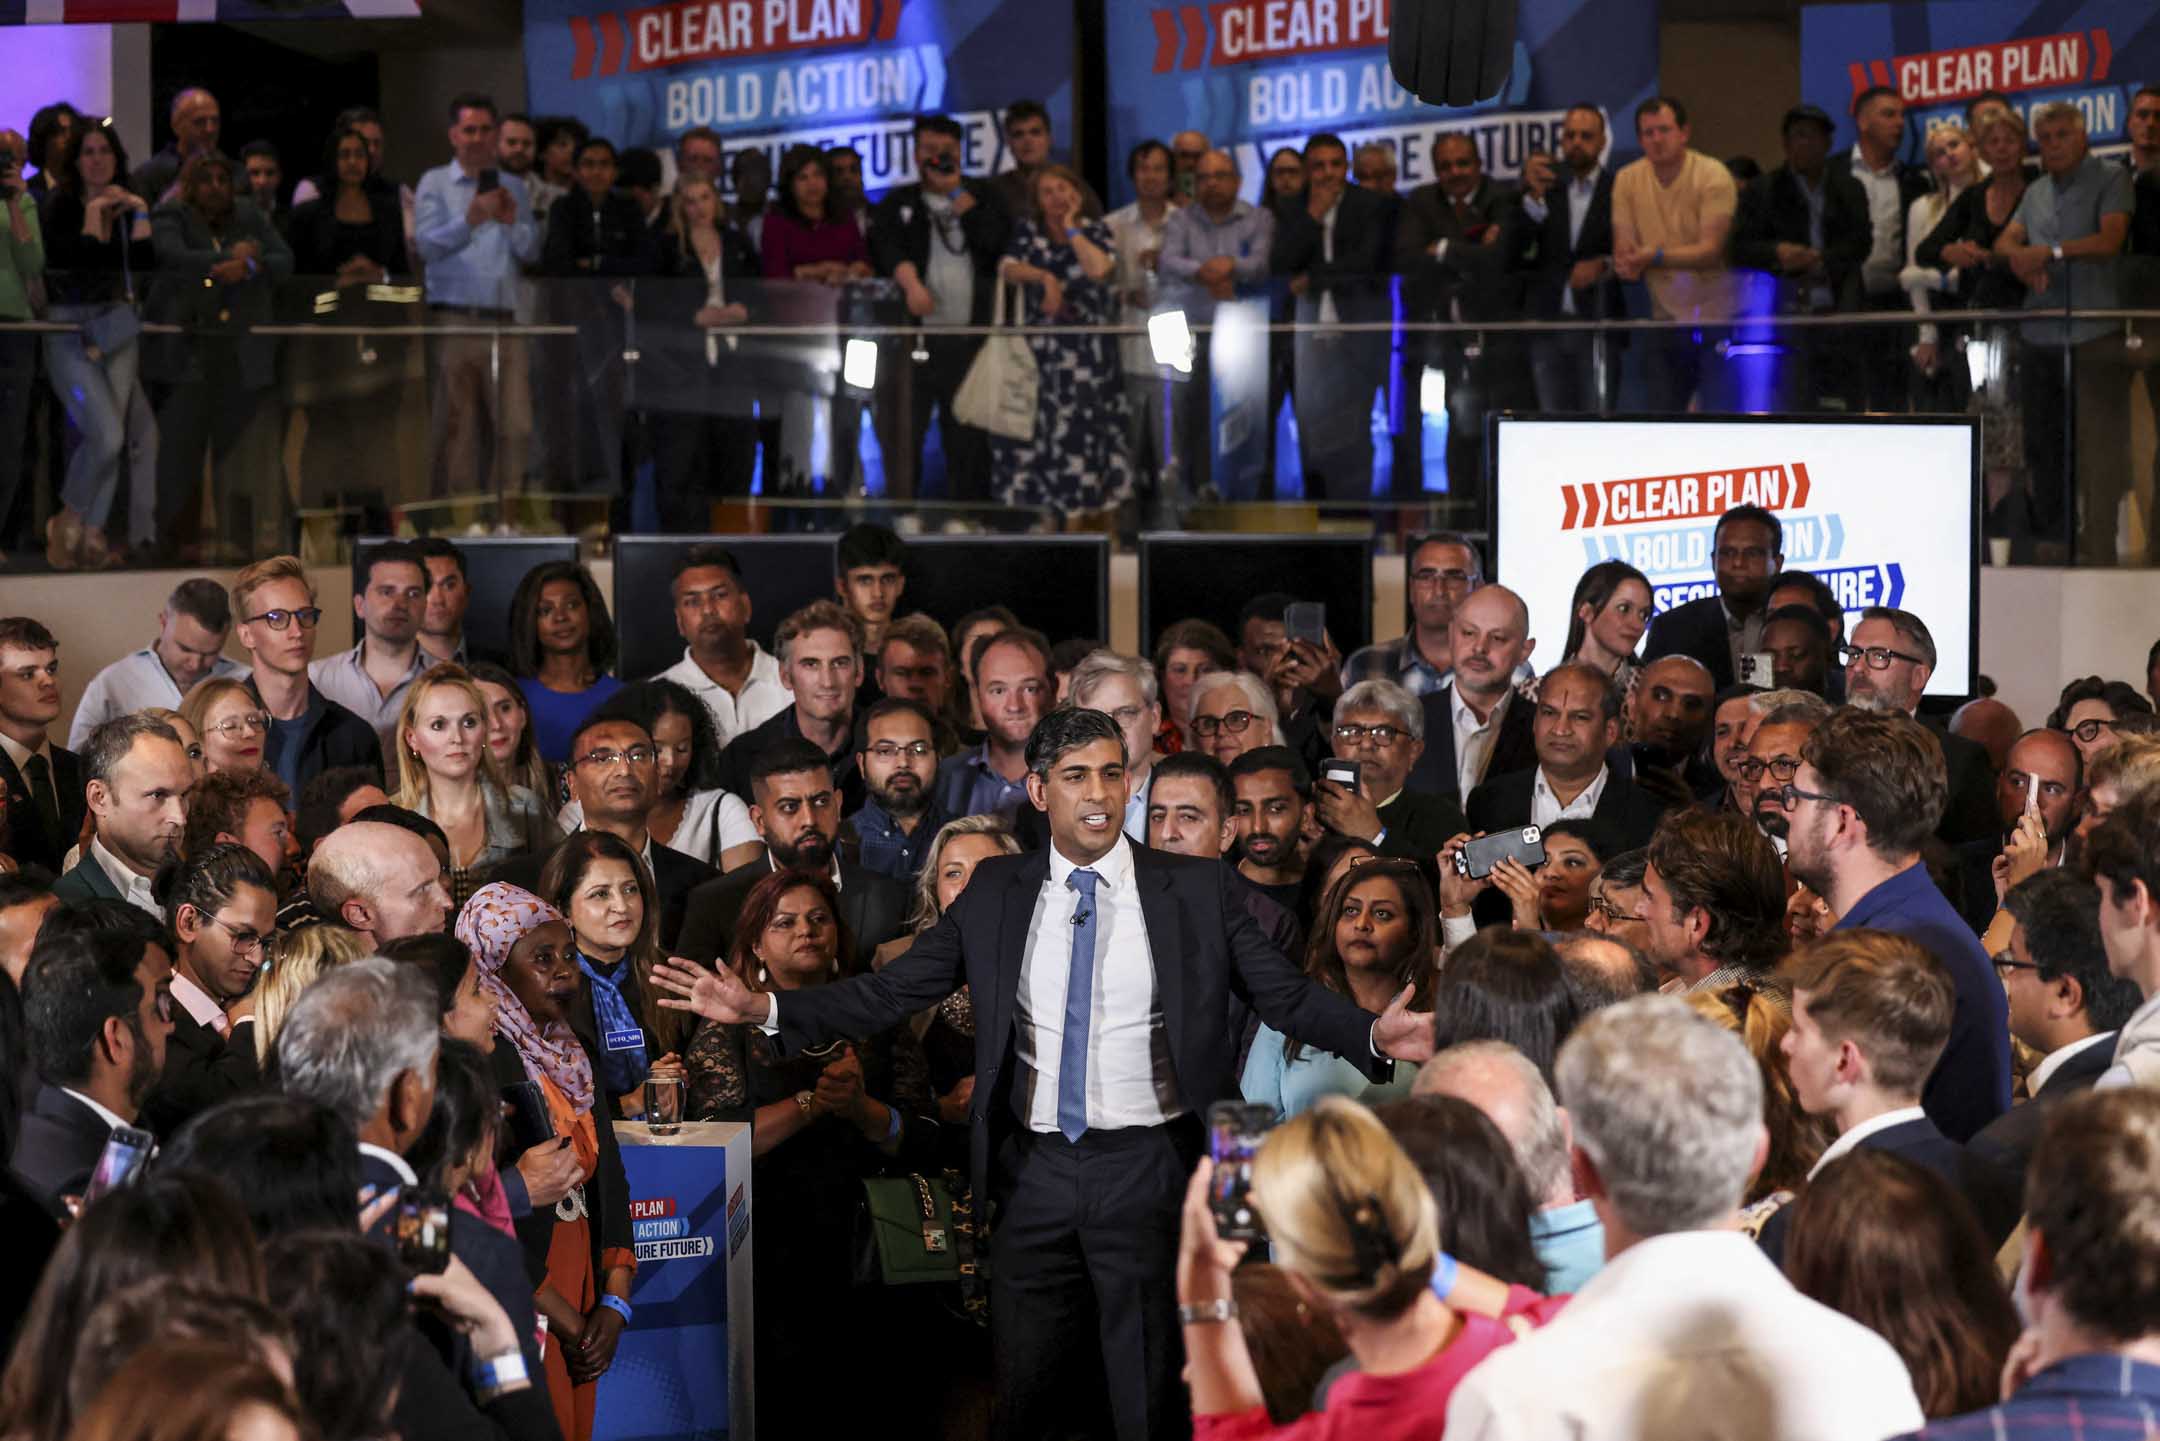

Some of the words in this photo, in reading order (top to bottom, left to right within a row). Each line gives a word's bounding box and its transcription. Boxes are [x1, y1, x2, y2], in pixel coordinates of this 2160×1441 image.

[638, 1, 753, 63] CLEAR
[763, 0, 862, 45] PLAN
[1221, 0, 1339, 57] CLEAR
[1350, 0, 1389, 41] PL
[667, 73, 762, 128] BOLD
[772, 54, 907, 118] ACTION
[1901, 51, 1993, 100] CLEAR
[2003, 38, 2079, 87] PLAN
[1249, 68, 1347, 125] BOLD
[1610, 478, 1699, 521] CLEAR
[1707, 469, 1780, 512] PLAN
[1633, 531, 1705, 572] BOLD
[635, 1200, 664, 1217] PLAN
[638, 1221, 678, 1238] ACTION
[636, 1242, 658, 1260] URE
[660, 1239, 702, 1257] FUTURE
